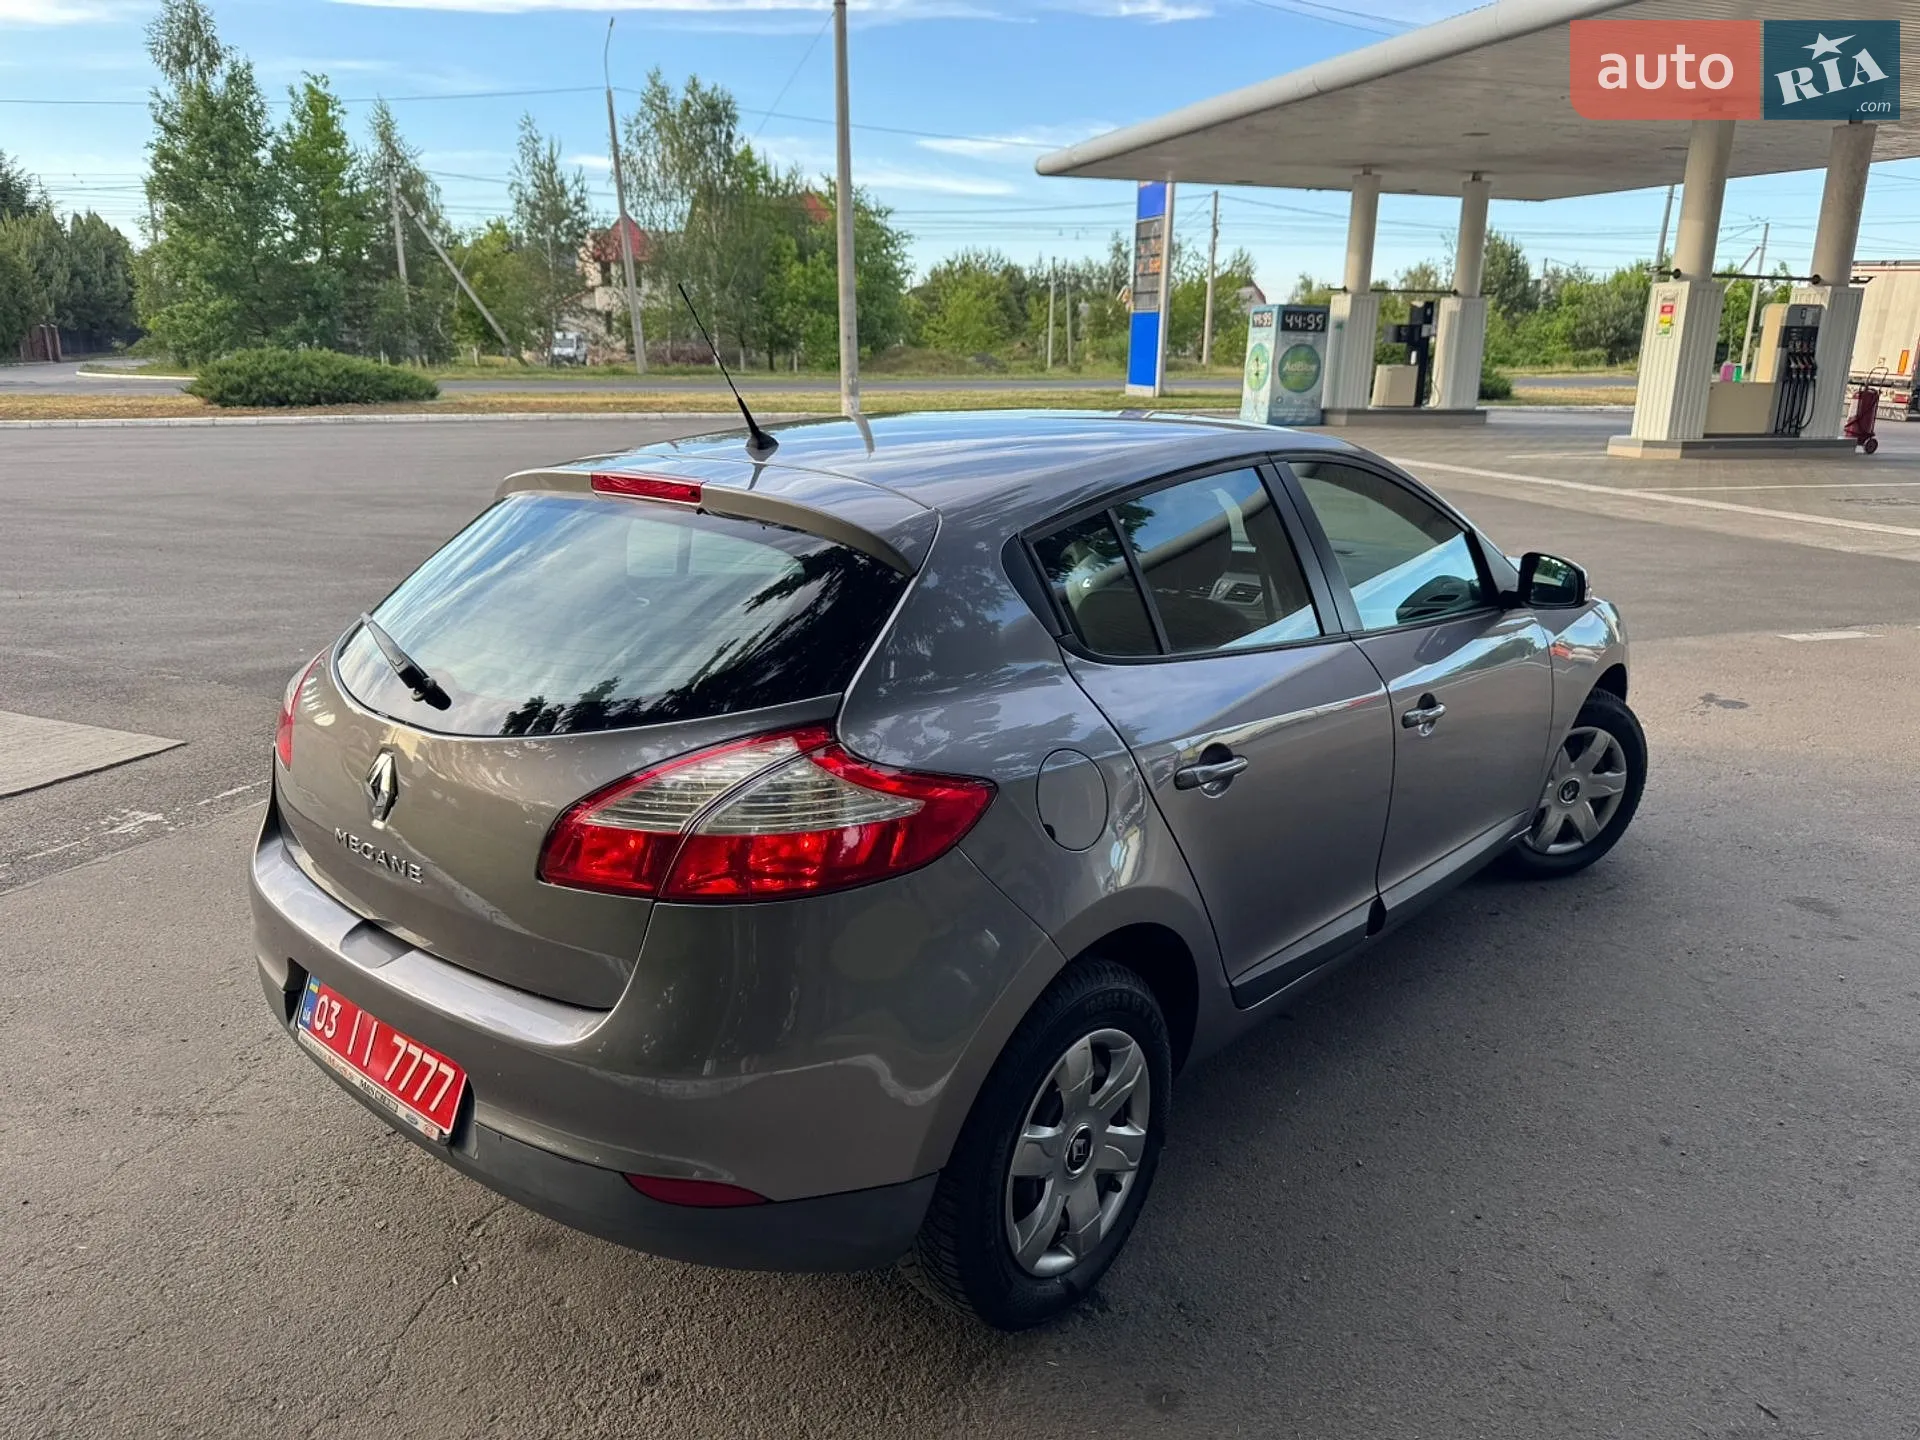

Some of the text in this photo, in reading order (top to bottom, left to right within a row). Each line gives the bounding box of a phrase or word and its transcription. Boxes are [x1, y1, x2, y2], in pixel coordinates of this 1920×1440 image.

[335, 827, 424, 884] MEGANE
[314, 994, 342, 1039] 03
[384, 1033, 456, 1112] 7777
